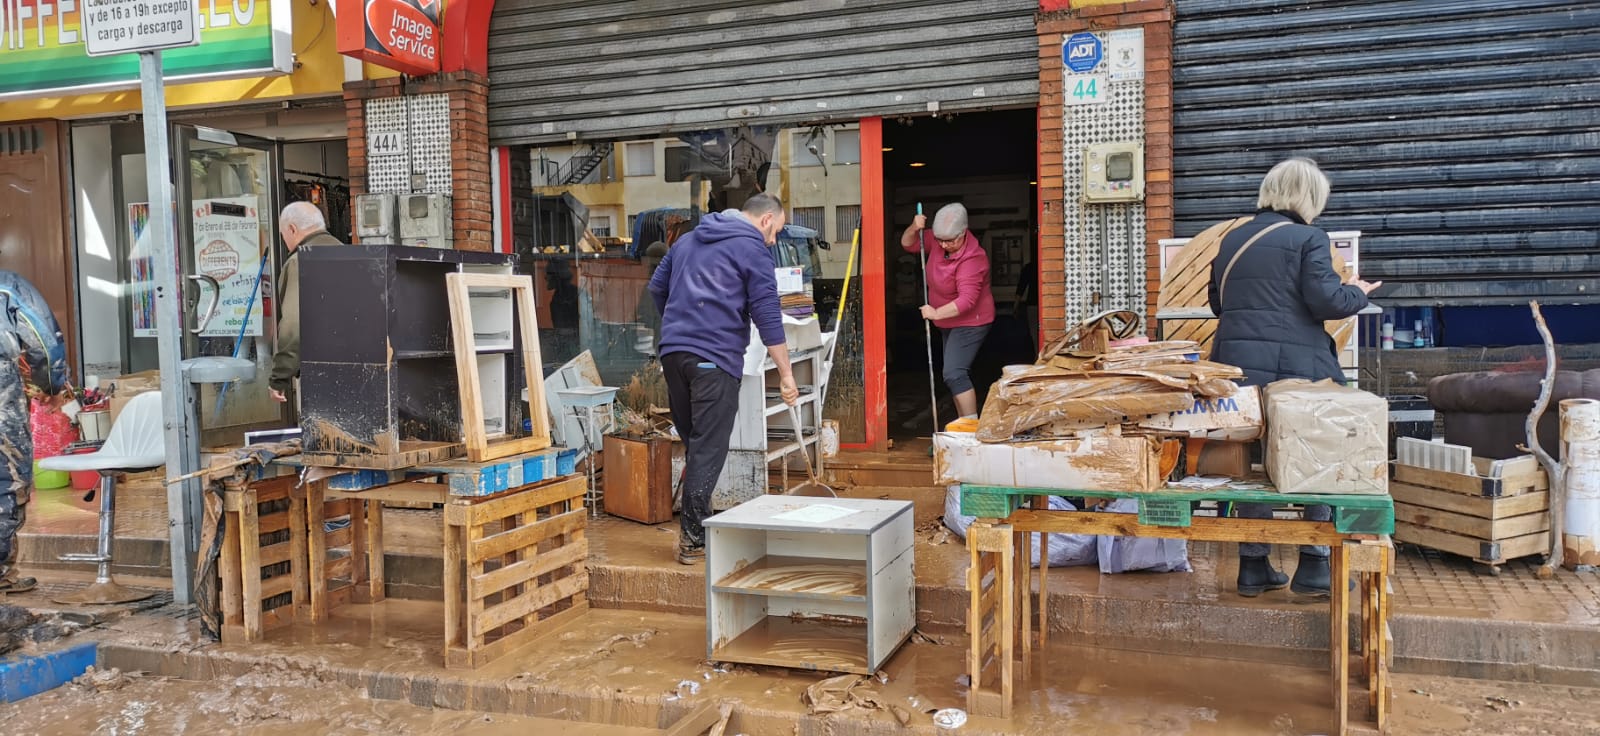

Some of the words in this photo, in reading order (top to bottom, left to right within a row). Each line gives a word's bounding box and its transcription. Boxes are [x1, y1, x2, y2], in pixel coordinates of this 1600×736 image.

[89, 12, 95, 26] y
[97, 8, 108, 22] de
[111, 6, 122, 20] 16
[124, 8, 131, 19] a
[133, 3, 150, 17] 19h
[152, 0, 188, 15] excepto
[98, 26, 126, 42] carga
[128, 26, 134, 39] y
[137, 19, 183, 36] descarga
[392, 9, 433, 41] Image
[389, 28, 435, 60] Service
[1070, 43, 1096, 60] ADT
[1073, 78, 1097, 99] 44
[374, 134, 398, 152] 44A
